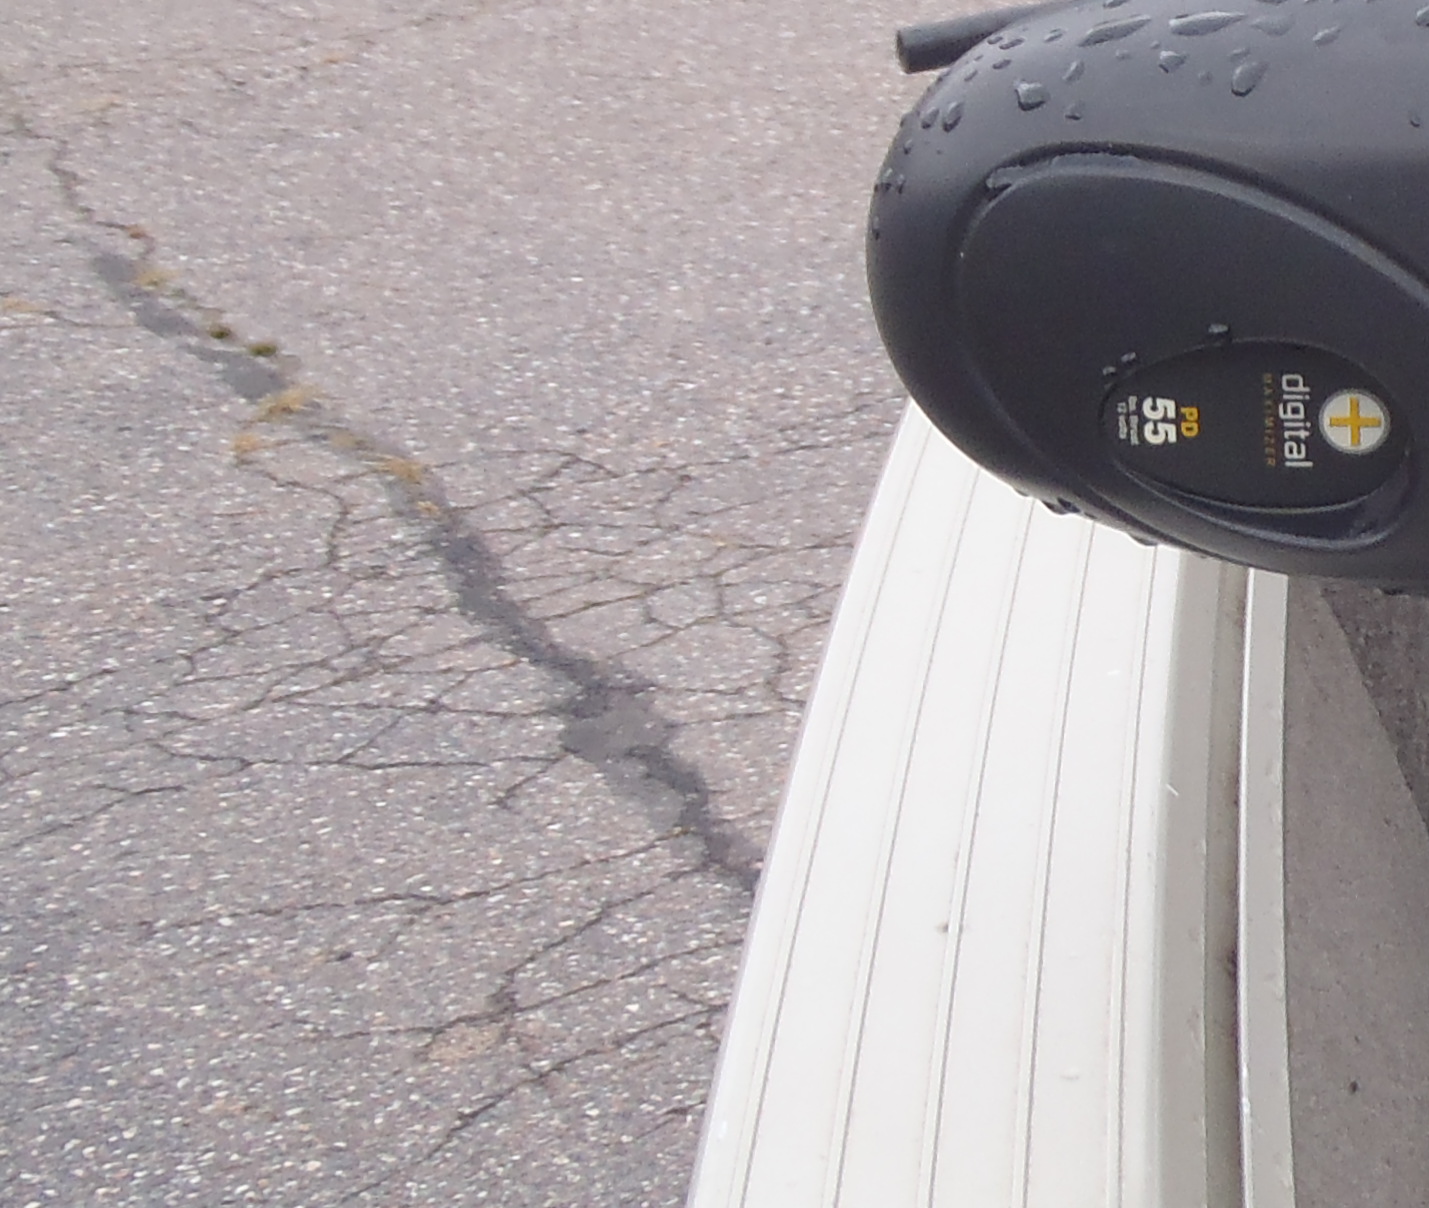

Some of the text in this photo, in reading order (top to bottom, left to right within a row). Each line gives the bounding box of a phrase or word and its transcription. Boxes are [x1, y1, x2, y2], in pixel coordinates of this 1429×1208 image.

[1142, 396, 1178, 446] 55
[1180, 406, 1199, 439] PD
[1278, 373, 1314, 469] digital
